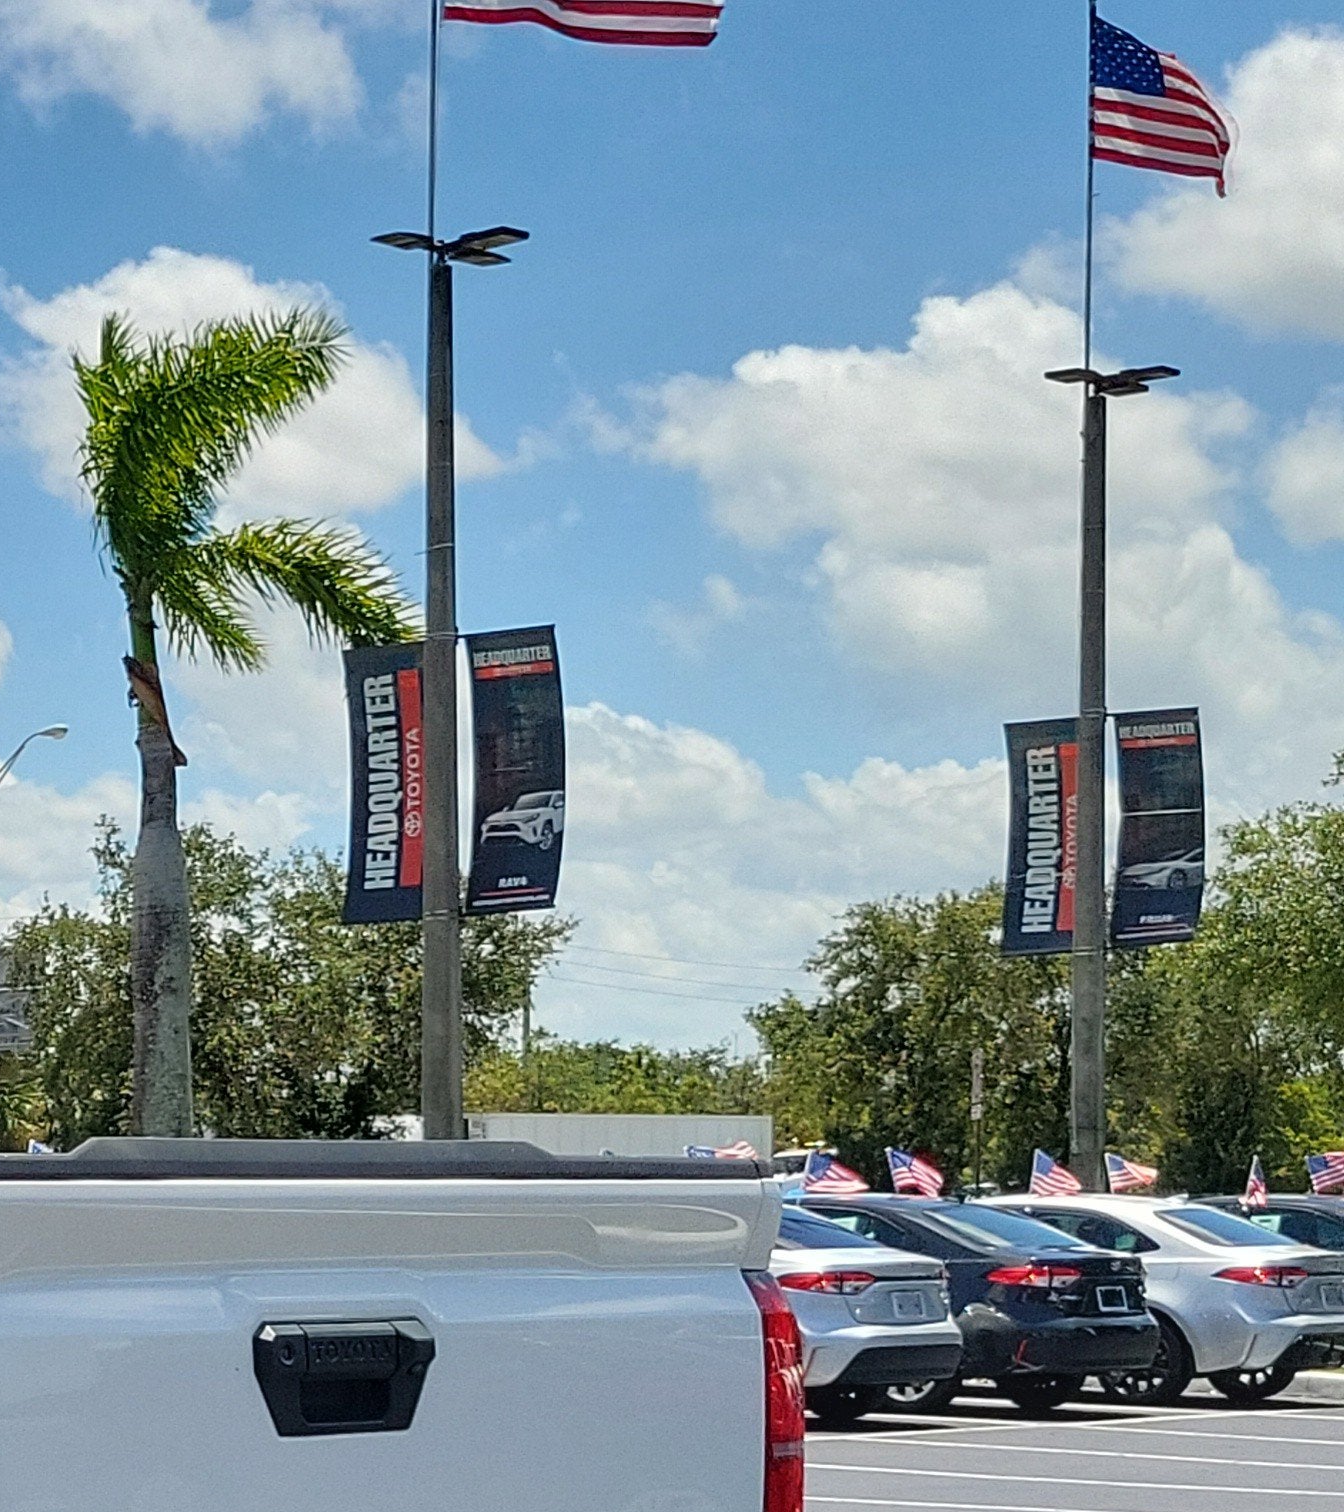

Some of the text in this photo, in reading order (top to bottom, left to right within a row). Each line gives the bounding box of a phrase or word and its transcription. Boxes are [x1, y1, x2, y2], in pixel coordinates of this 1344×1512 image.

[473, 645, 553, 668] HEADQUARTER
[363, 673, 396, 891] HEADQUARTER
[406, 727, 422, 809] TOYOTA
[1021, 745, 1060, 933] HEADQUARTER
[498, 876, 529, 888] RAV4
